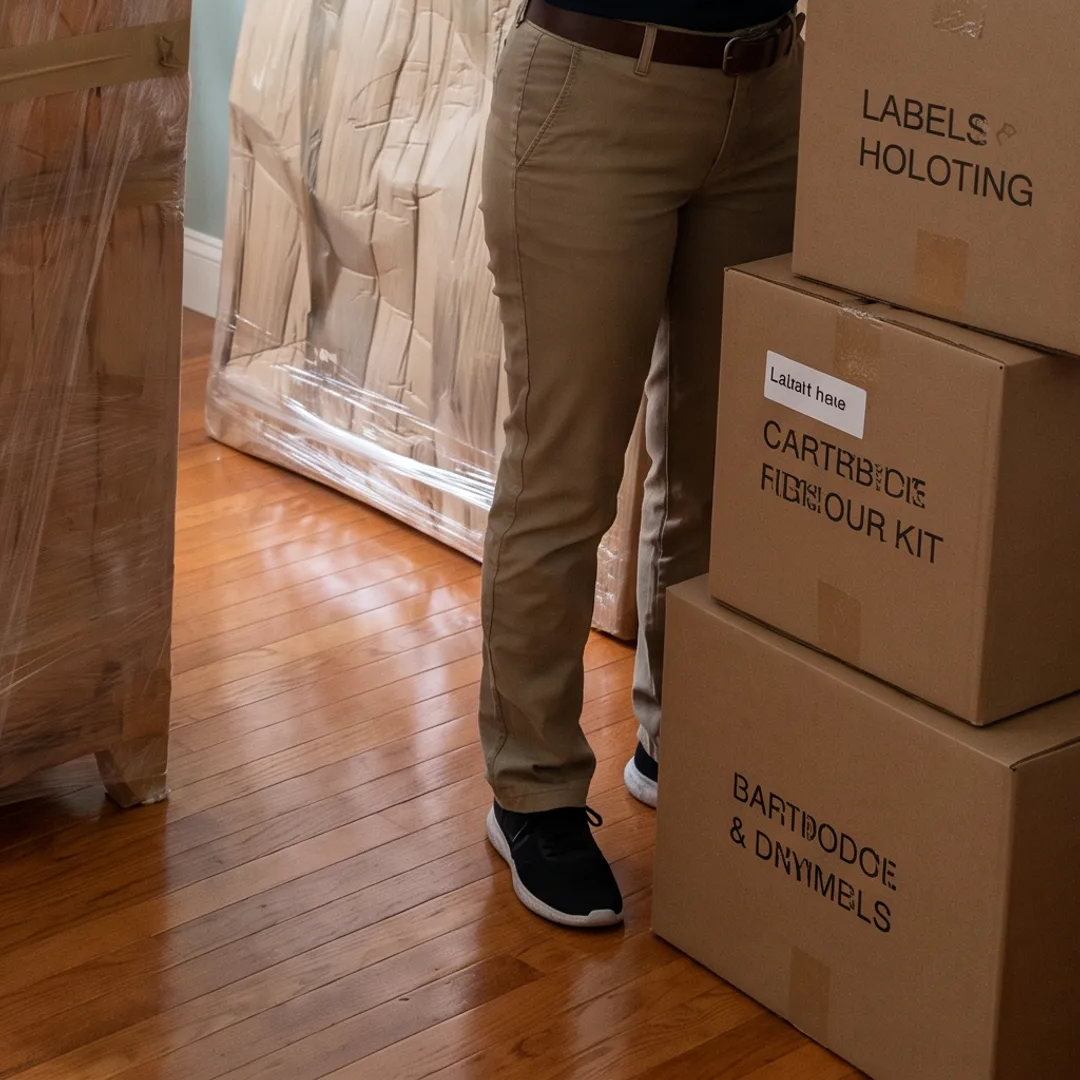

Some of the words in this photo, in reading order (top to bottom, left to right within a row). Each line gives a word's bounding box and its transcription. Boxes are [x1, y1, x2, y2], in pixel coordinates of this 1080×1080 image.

[862, 89, 988, 146] LABELS
[859, 136, 1033, 207] HOLOTING
[894, 519, 944, 564] KIT
[730, 816, 746, 848] &
